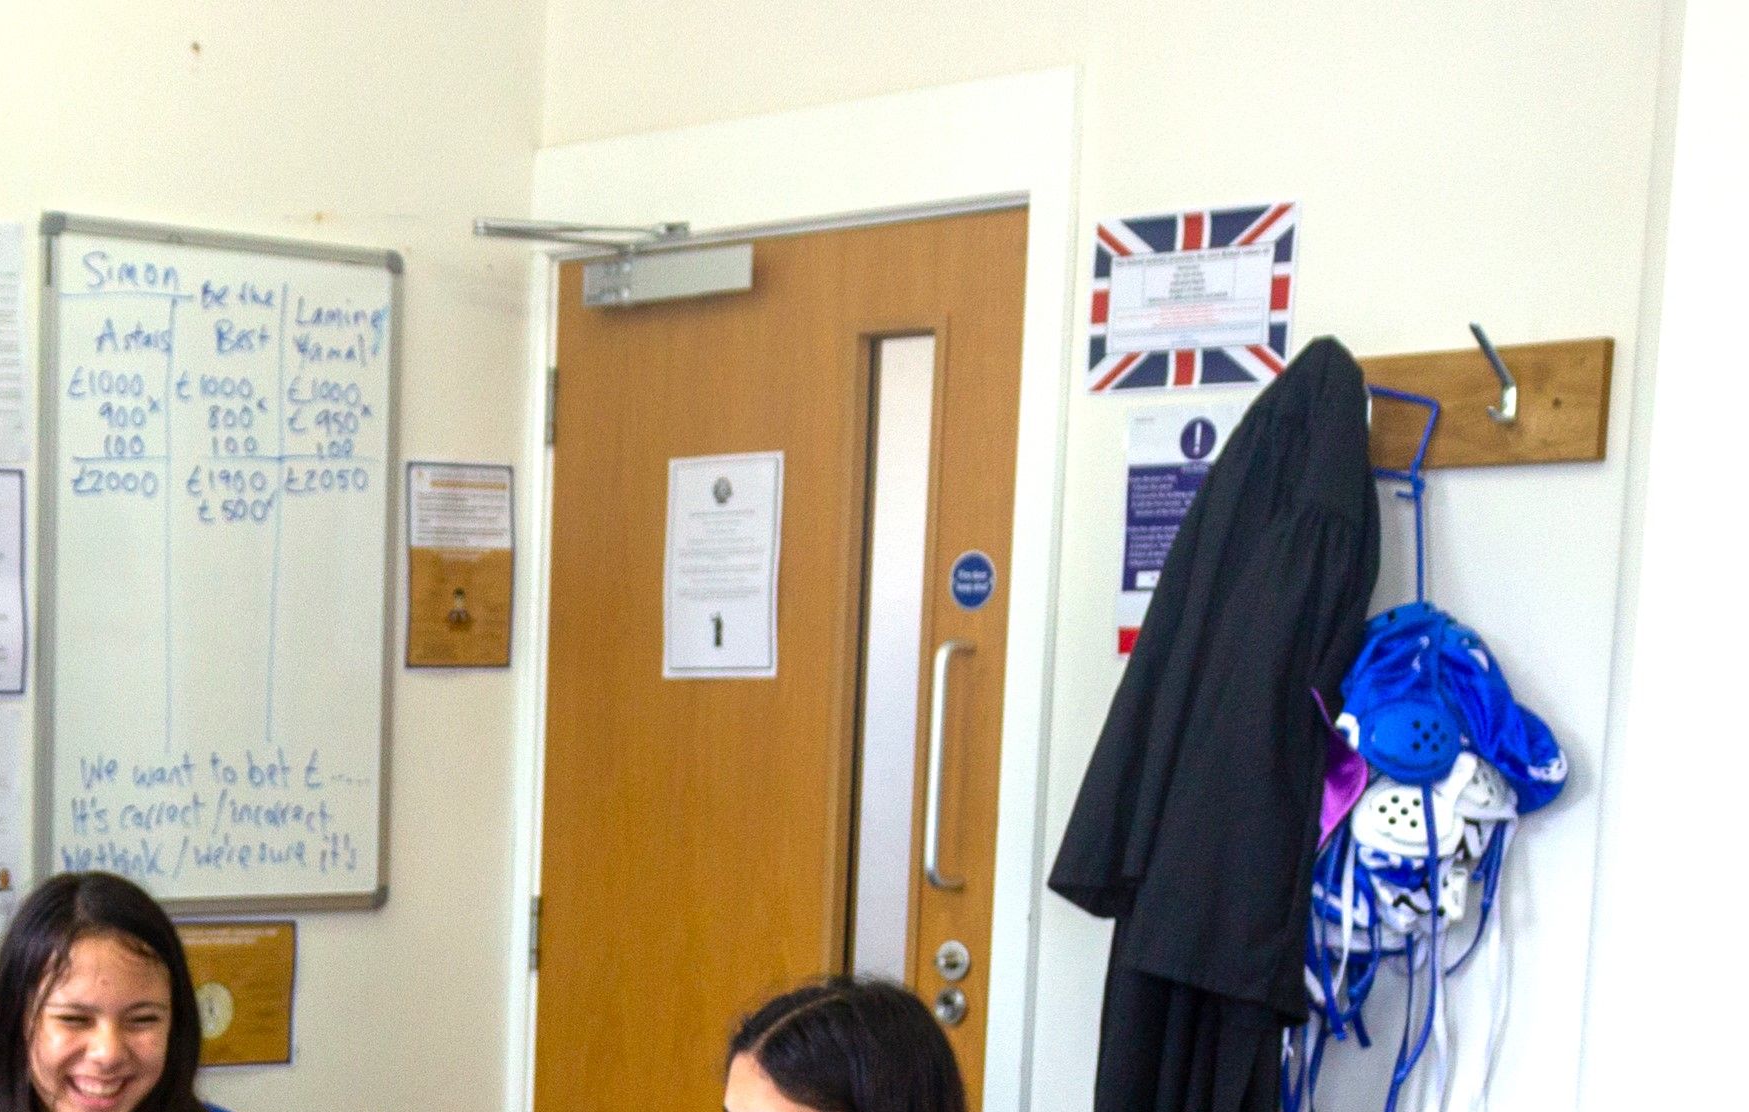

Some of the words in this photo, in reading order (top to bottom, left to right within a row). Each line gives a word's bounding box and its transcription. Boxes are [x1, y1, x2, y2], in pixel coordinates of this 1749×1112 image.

[82, 250, 180, 290] Simon
[67, 366, 145, 400] £1000
[99, 400, 147, 429] 900
[208, 404, 254, 432] 800
[103, 434, 145, 460] 100
[211, 435, 257, 459] 100
[315, 438, 354, 460] 100
[70, 464, 159, 498] £2000
[285, 467, 370, 494] £2050
[80, 754, 119, 791] We
[133, 750, 196, 788] want
[209, 750, 239, 786] to
[245, 747, 291, 791] bet
